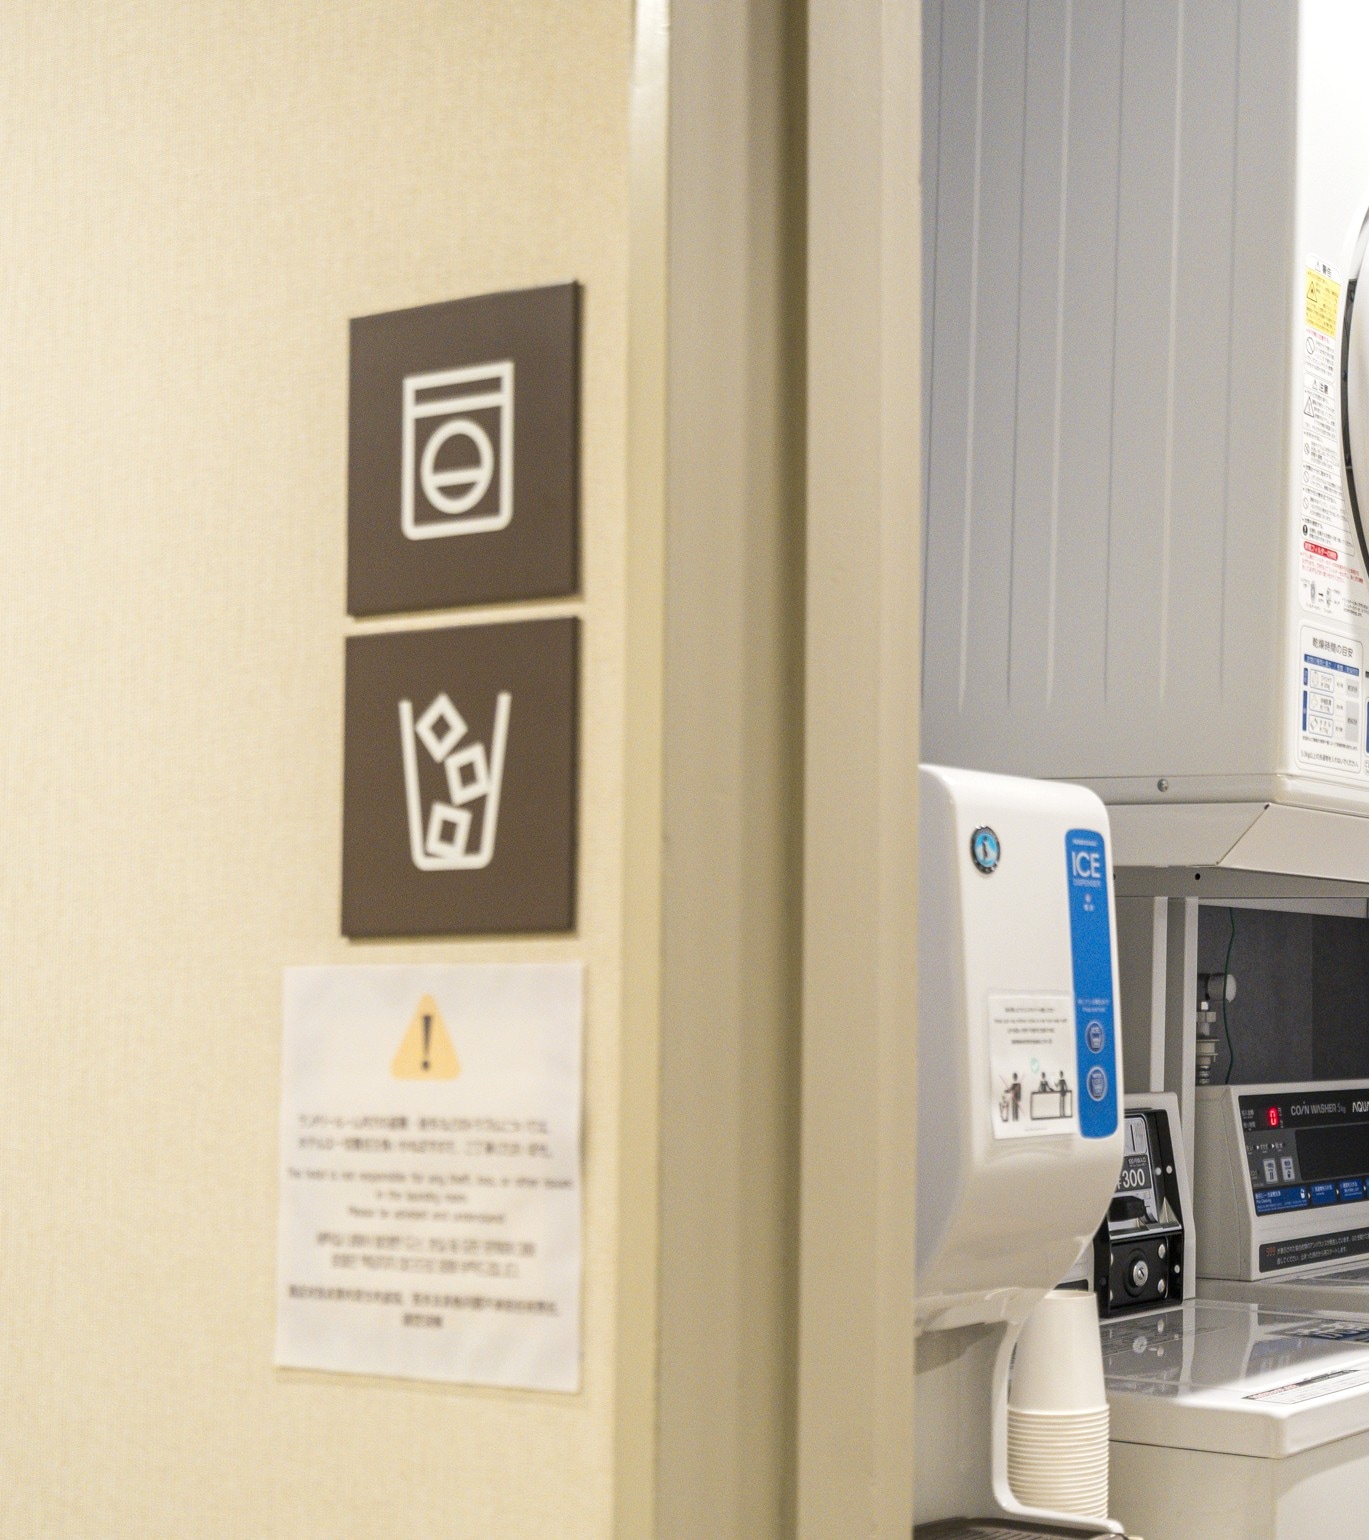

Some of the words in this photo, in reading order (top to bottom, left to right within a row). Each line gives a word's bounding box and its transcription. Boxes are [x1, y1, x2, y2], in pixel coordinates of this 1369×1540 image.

[1072, 852, 1101, 878] ICE
[1268, 1108, 1279, 1127] 0
[1310, 1103, 1336, 1115] WASHER
